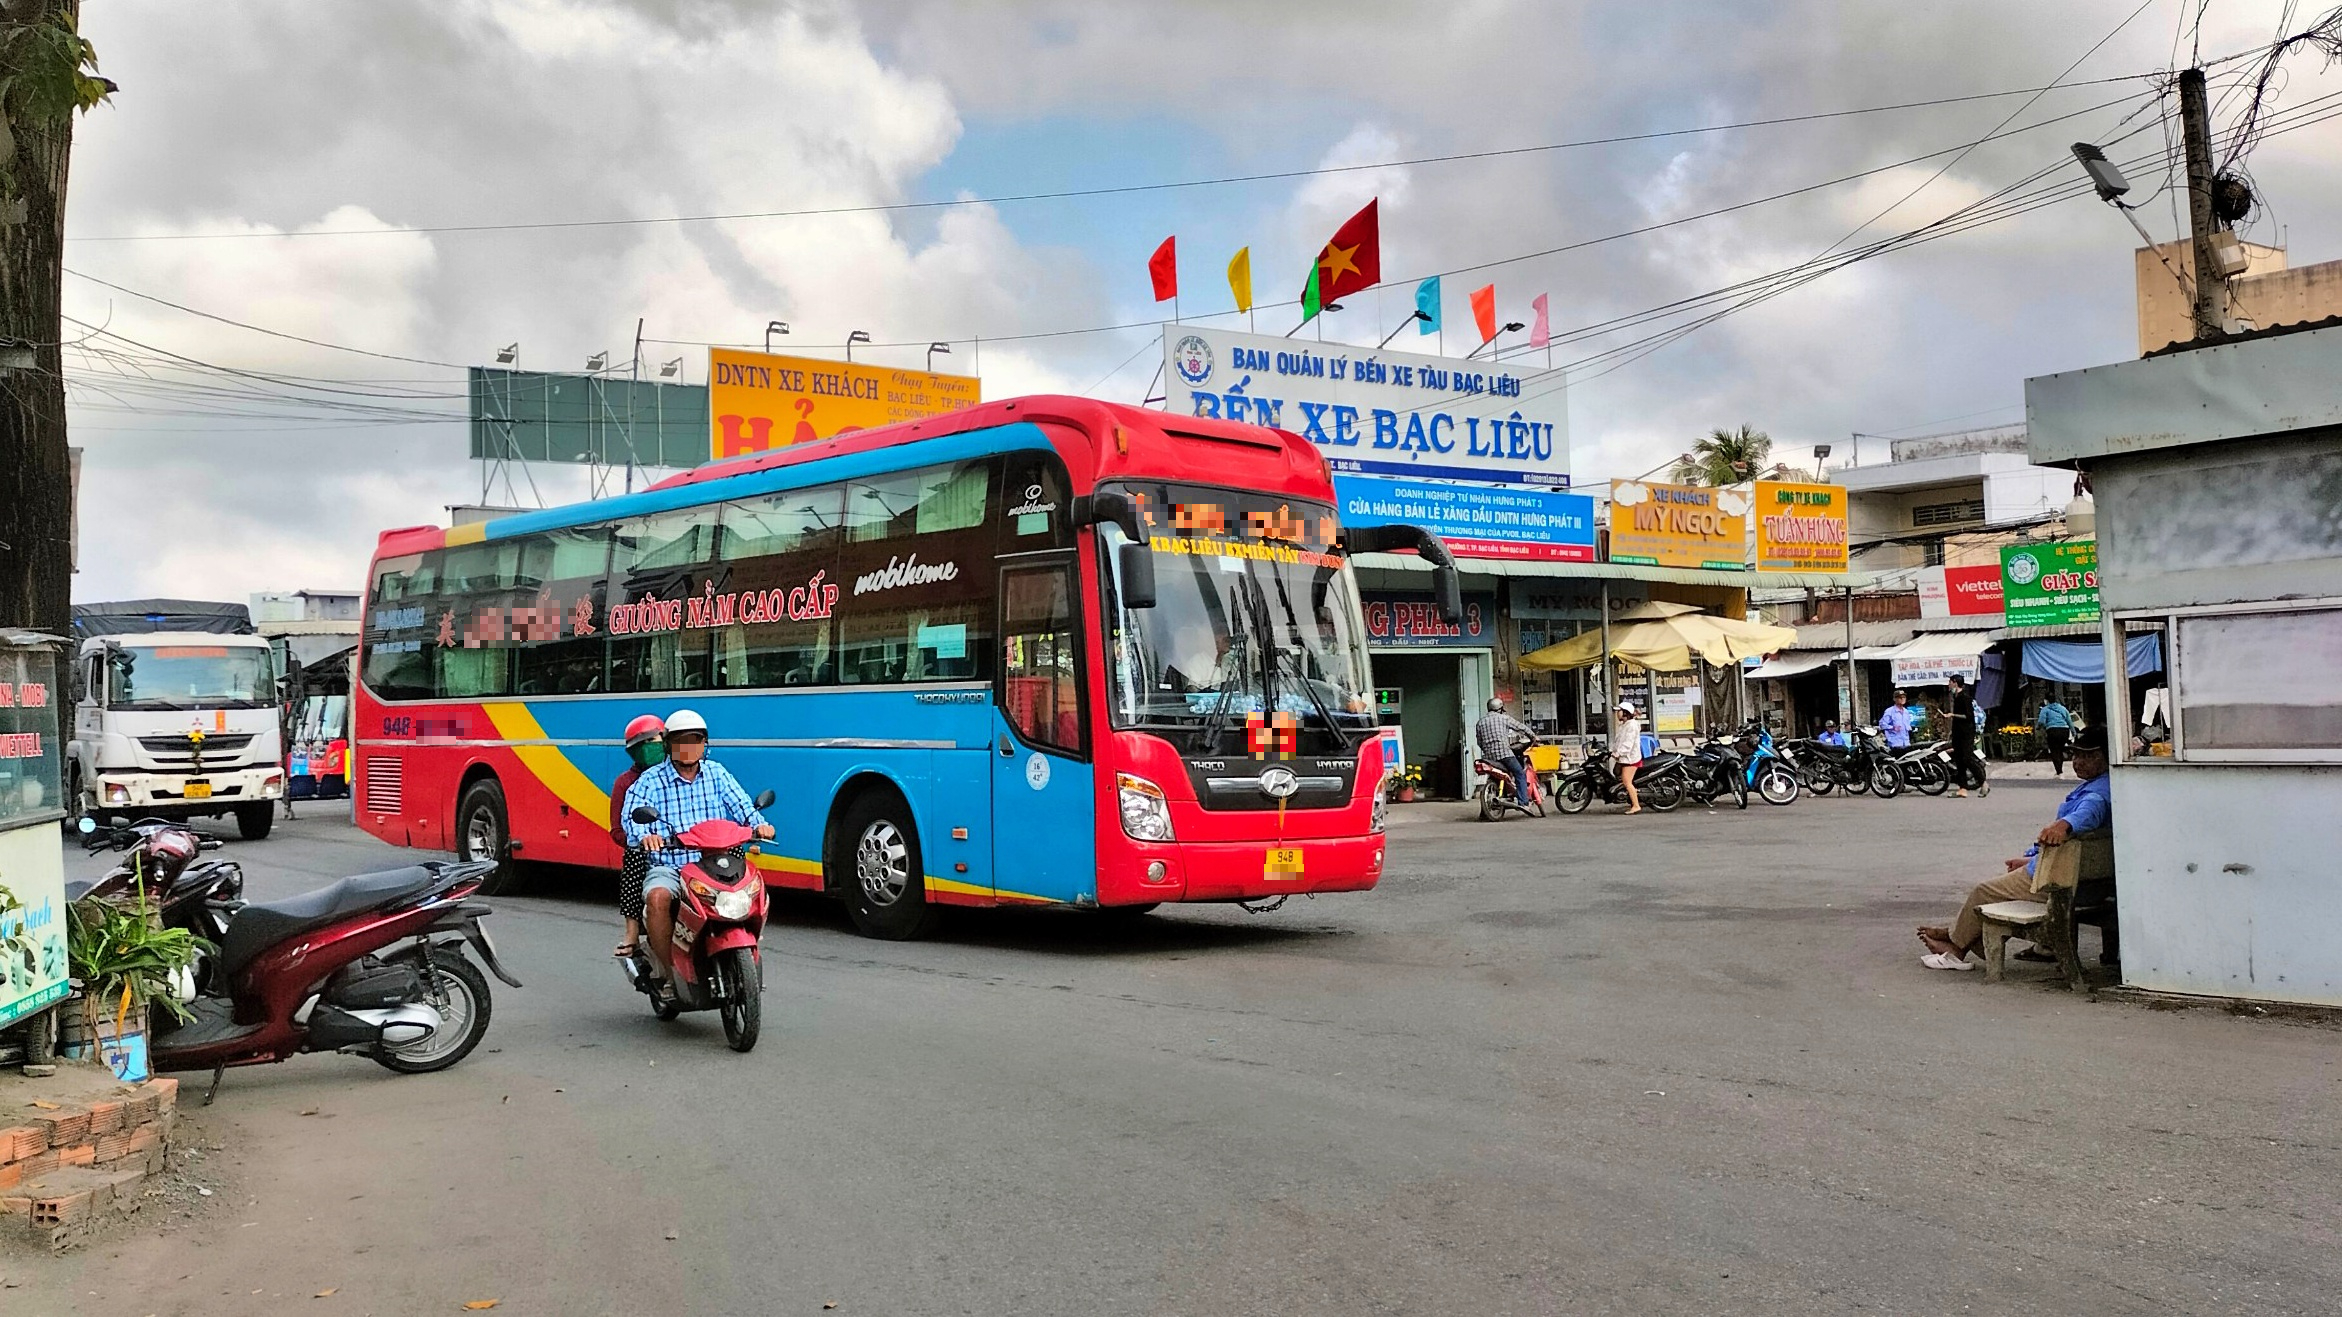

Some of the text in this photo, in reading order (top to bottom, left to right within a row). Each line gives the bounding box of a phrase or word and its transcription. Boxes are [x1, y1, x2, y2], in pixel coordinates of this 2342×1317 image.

[716, 362, 879, 400] DNTN XE KHÁCH
[891, 371, 923, 390] Chạy
[1232, 347, 1520, 397] BAN QUẢN LÝ BẾN XE TÀU BẠC LIÊU
[1191, 374, 1554, 461] BẾN XE BẠC LIÊU
[1395, 488, 1423, 499] DOANH
[1425, 490, 1455, 503] NGHIỆP
[1516, 496, 1535, 508] PHÁT
[1537, 499, 1543, 508] 3
[1653, 488, 1668, 502] XE
[1008, 500, 1056, 517] mobihome
[1348, 496, 1371, 515] CỬA
[1373, 499, 1402, 518] HÀNG
[1404, 502, 1426, 519] BÁN
[1428, 502, 1441, 520] LẺ
[1442, 505, 1470, 522] XĂNG
[1495, 511, 1520, 526] DNTN
[1549, 513, 1573, 529] PHÁT
[1634, 505, 1670, 532] MỸ
[1670, 508, 1728, 542] NGỌC
[1190, 536, 1222, 556] LIÊU
[1276, 545, 1299, 564] TÂY
[853, 553, 959, 597] mobihome
[1955, 579, 2004, 593] viettel
[2041, 568, 2082, 594] GIẶT
[608, 591, 682, 635] GIƯỜNG
[738, 588, 784, 624] CAO
[787, 569, 840, 621] CẤP
[1467, 603, 1481, 637] 3
[21, 683, 46, 708] MOBI
[1191, 761, 1225, 771] THACO
[1316, 760, 1354, 770] HYUNDAI
[1277, 851, 1294, 863] 94B
